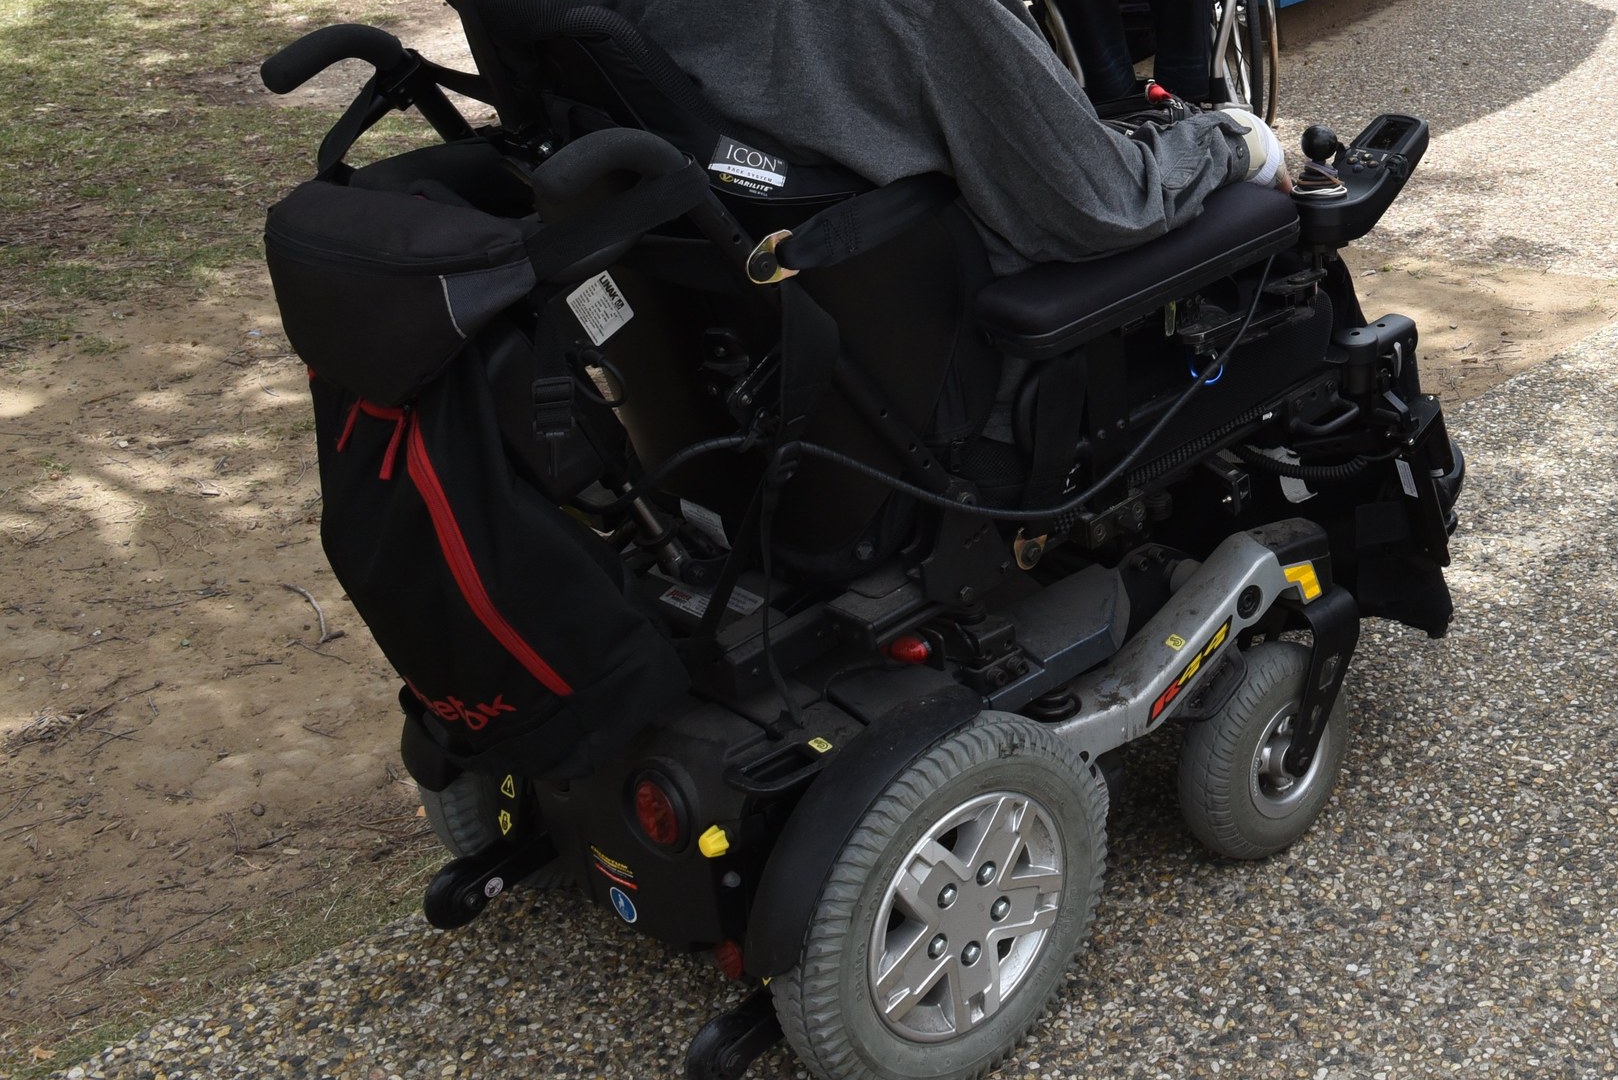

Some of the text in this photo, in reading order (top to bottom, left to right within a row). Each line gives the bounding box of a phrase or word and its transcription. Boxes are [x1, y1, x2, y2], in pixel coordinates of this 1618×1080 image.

[727, 165, 773, 183] BACK SYSTEM
[598, 274, 619, 301] LINAK
